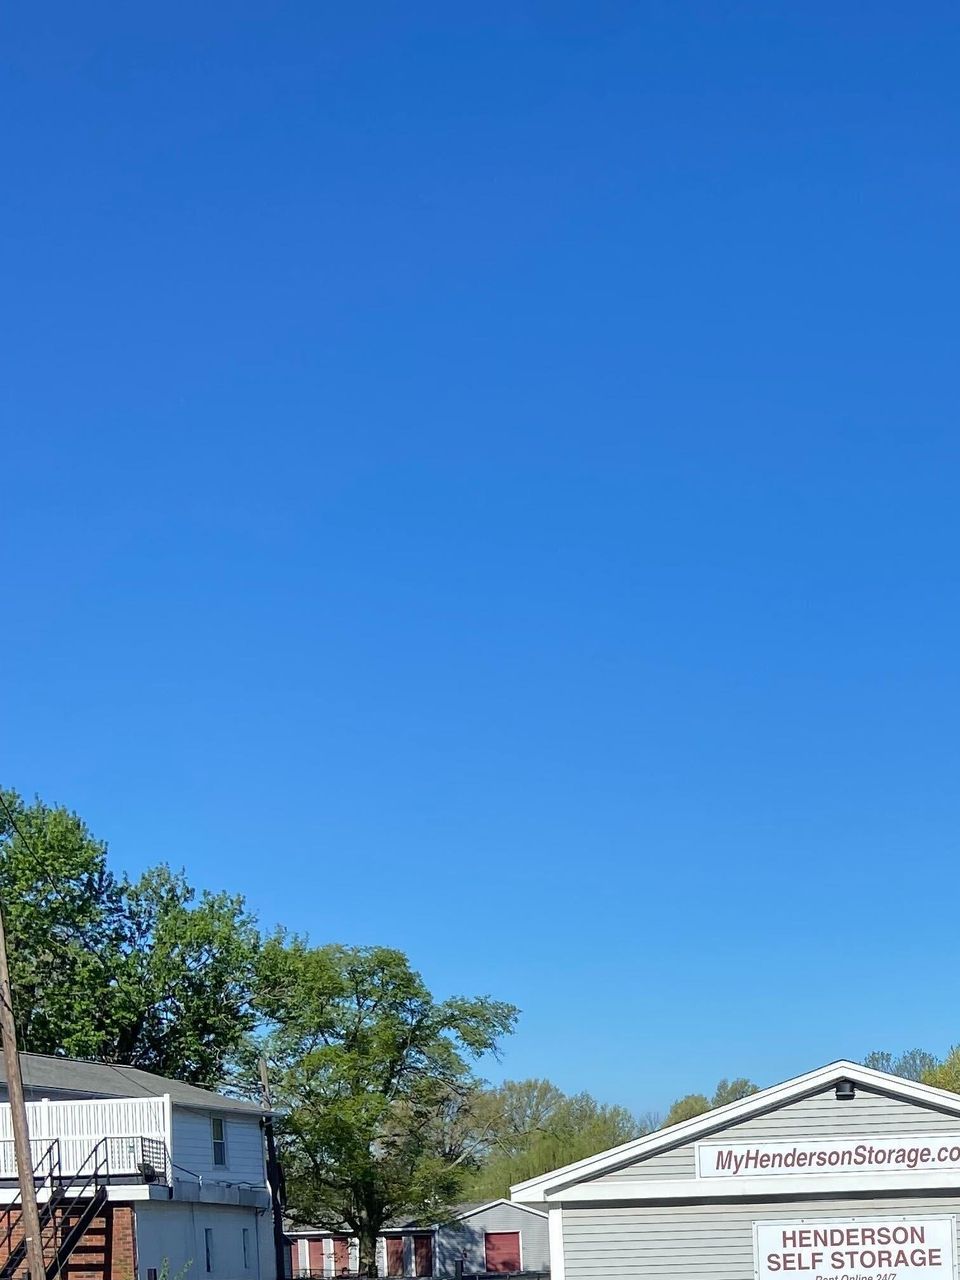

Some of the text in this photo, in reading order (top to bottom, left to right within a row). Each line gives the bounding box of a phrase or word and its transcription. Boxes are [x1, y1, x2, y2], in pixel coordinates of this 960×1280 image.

[782, 1226, 925, 1248] HENDERSON
[767, 1248, 942, 1271] SELF STORAGE
